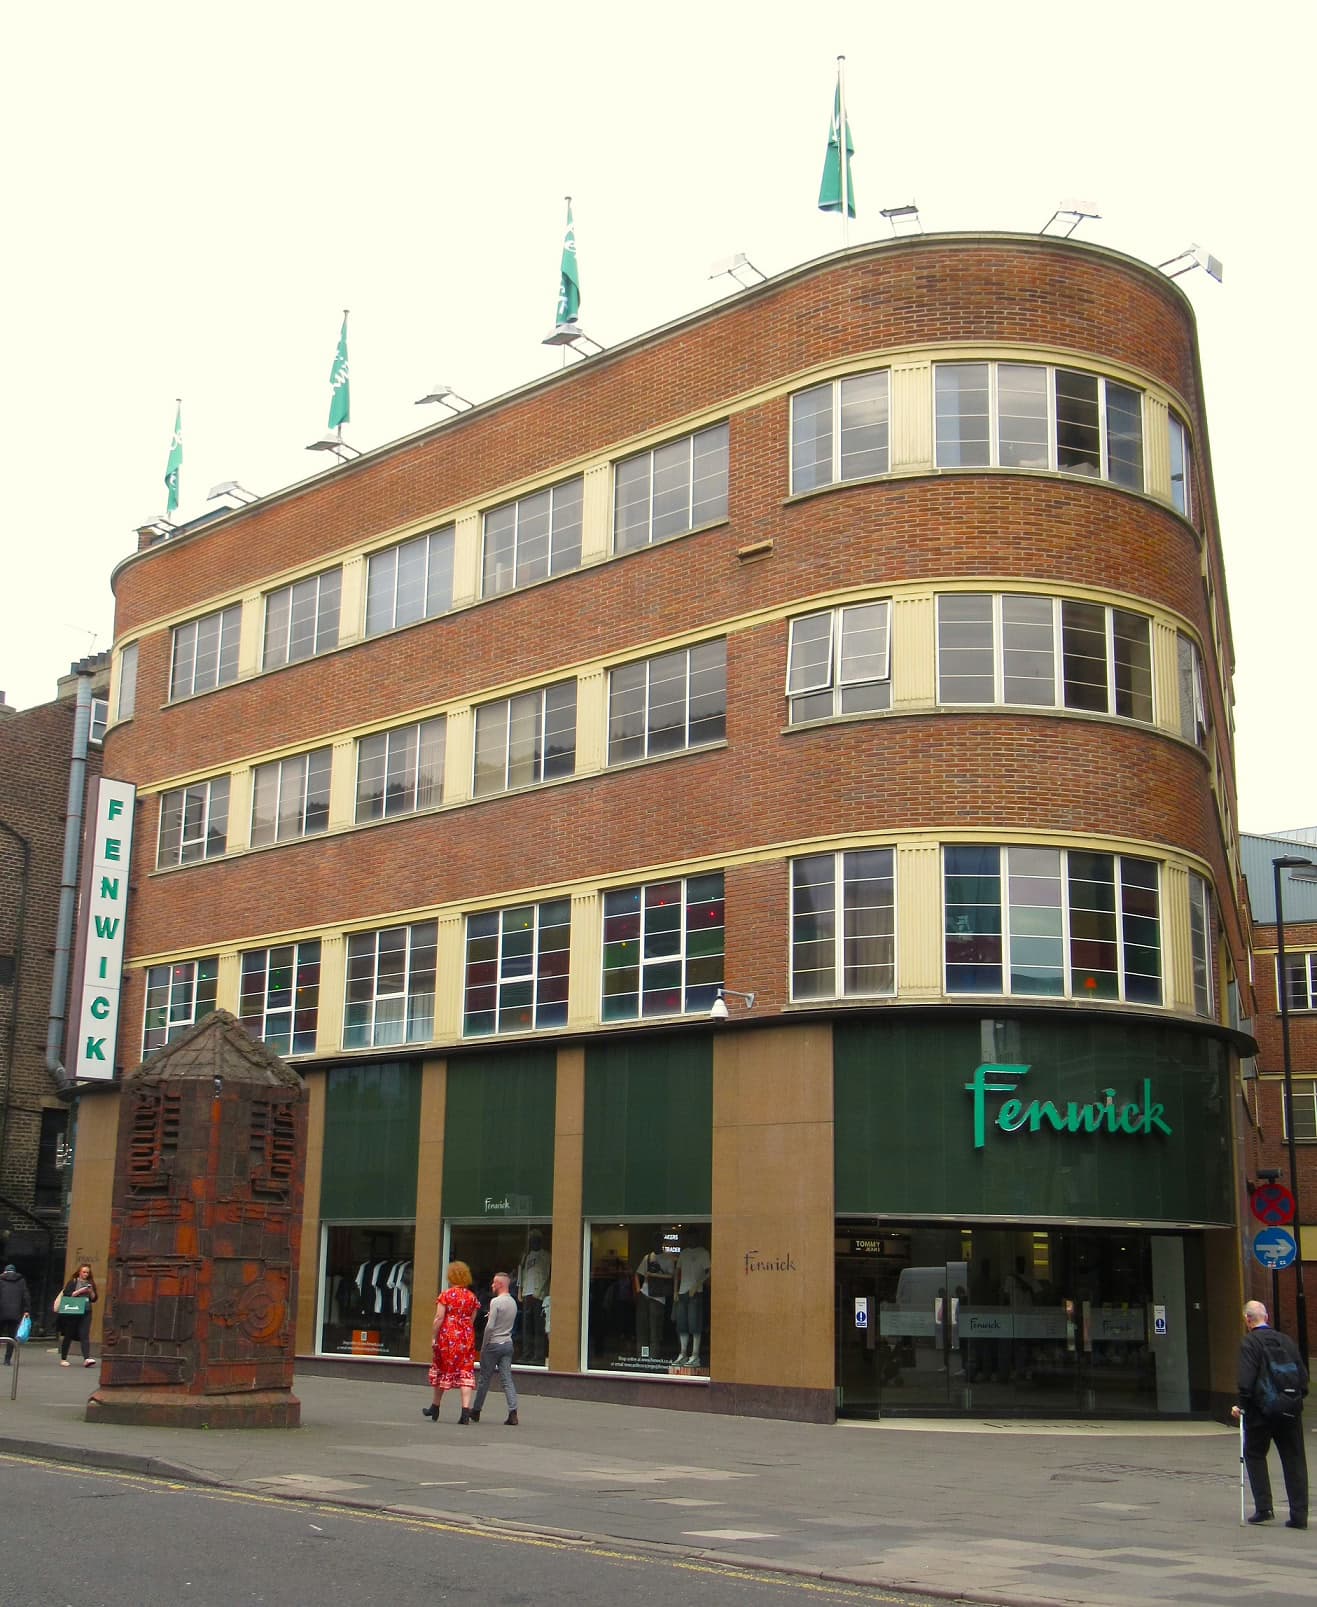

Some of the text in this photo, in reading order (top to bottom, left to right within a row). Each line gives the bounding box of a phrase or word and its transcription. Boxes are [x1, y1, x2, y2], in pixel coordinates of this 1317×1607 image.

[85, 799, 124, 1061] FENWICK
[965, 1063, 1173, 1148] Fenwick
[484, 1197, 510, 1212] Fenwick
[744, 1250, 797, 1274] Fenwick
[970, 1317, 1001, 1331] Fenwick
